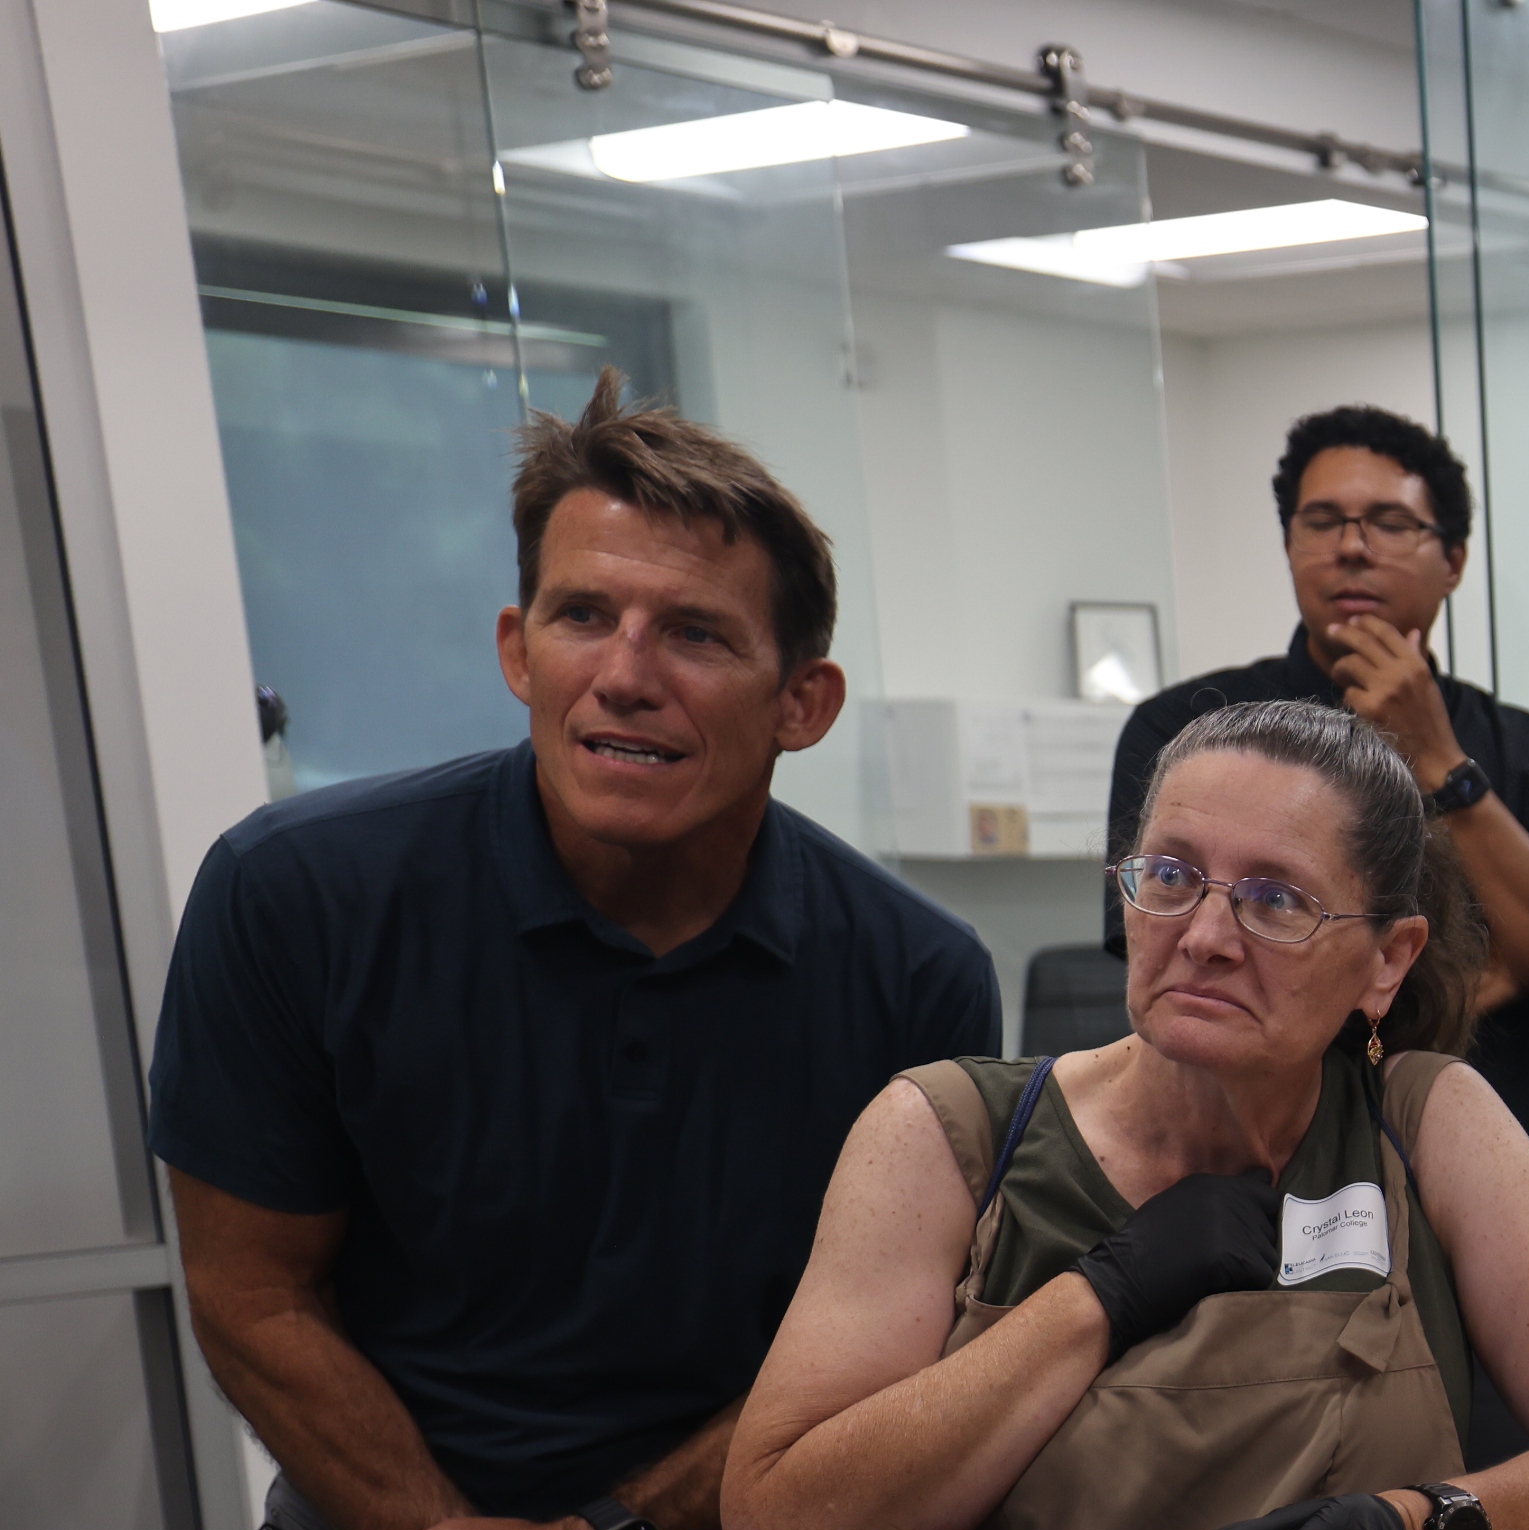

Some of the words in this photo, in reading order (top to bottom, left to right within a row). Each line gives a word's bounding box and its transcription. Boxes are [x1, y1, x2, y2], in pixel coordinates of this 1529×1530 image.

[1302, 1212, 1341, 1236] Crystal
[1344, 1209, 1374, 1220] Leon
[1312, 1224, 1338, 1241] Palomar
[1340, 1220, 1368, 1229] College
